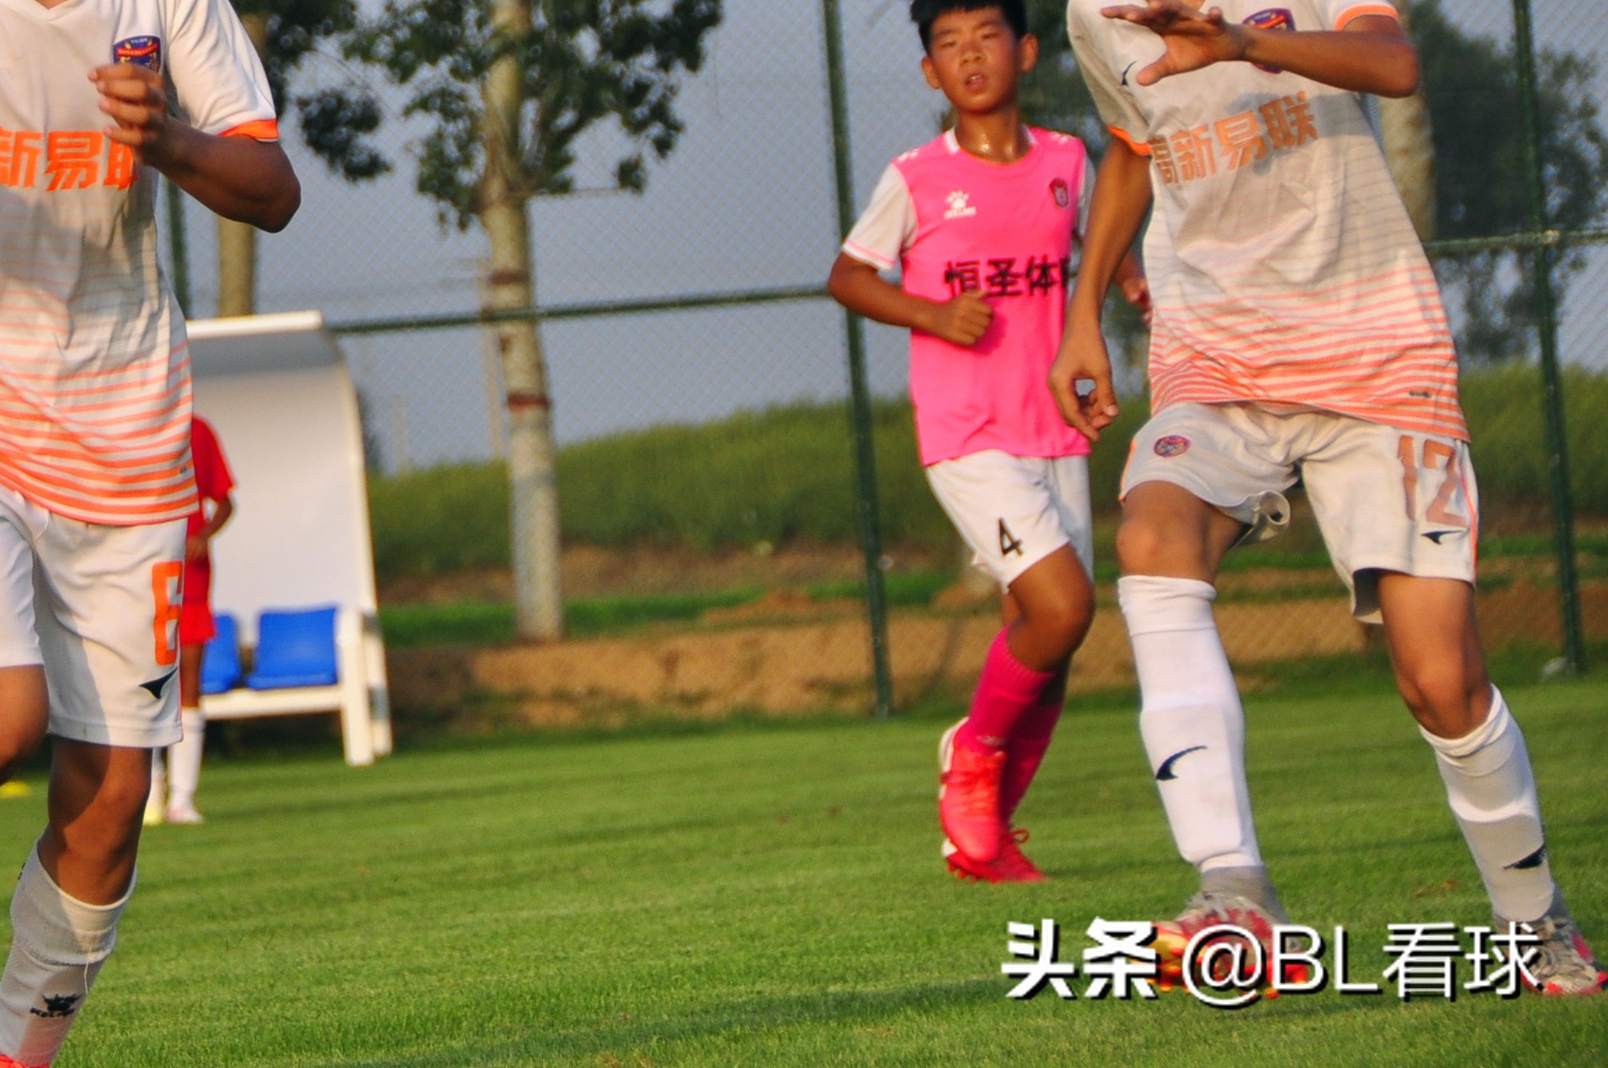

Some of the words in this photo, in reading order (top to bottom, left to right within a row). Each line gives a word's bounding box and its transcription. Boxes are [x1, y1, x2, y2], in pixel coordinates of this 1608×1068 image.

[1147, 90, 1319, 186] 高新易联
[1396, 434, 1468, 528] 12
[998, 517, 1023, 558] 4
